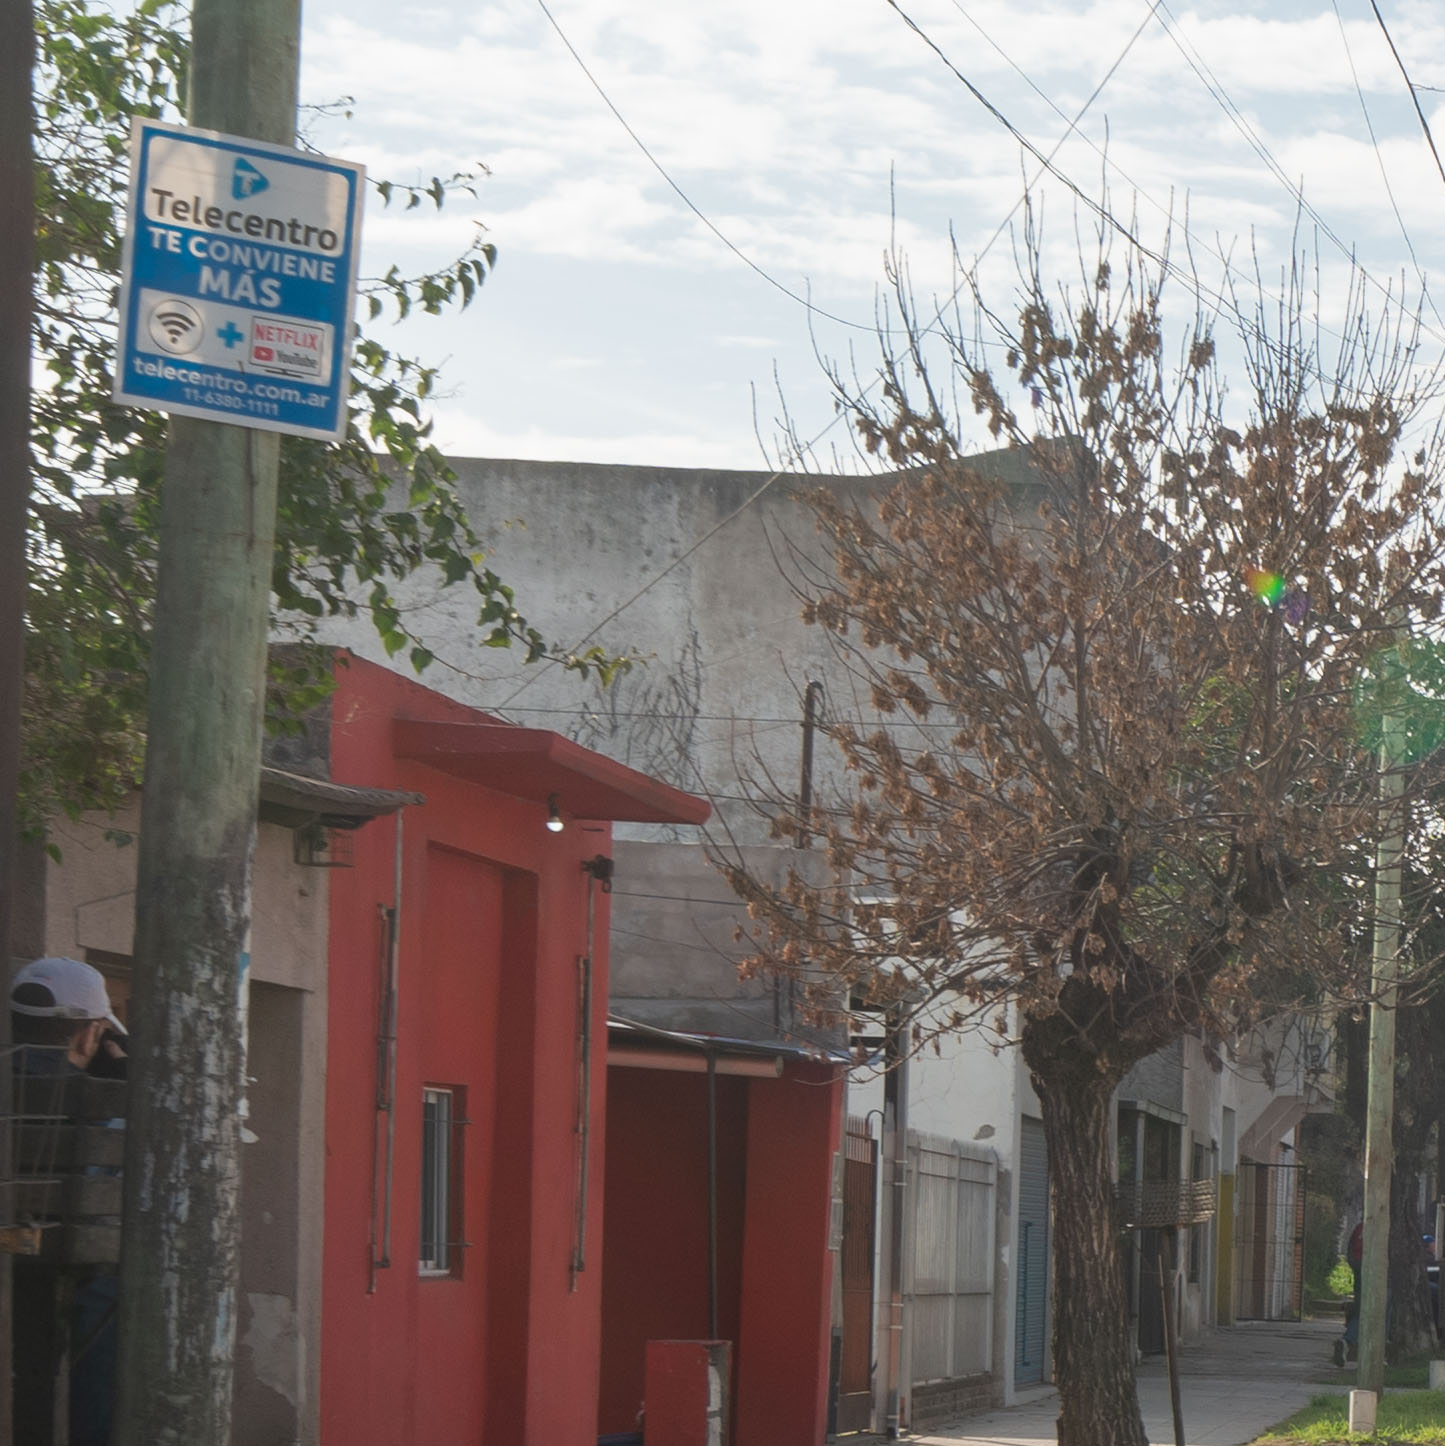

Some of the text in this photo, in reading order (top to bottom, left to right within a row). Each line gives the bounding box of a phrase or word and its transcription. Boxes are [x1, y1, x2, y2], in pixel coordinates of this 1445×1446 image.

[151, 187, 338, 252] Telecentro
[147, 226, 336, 283] TE CONVIENE
[199, 265, 281, 308] MÁS
[254, 324, 321, 351] NETFLIX
[276, 349, 319, 369] YouTube
[133, 356, 331, 409] telecentro.com.ar
[182, 386, 280, 416] 11-6380-1111
